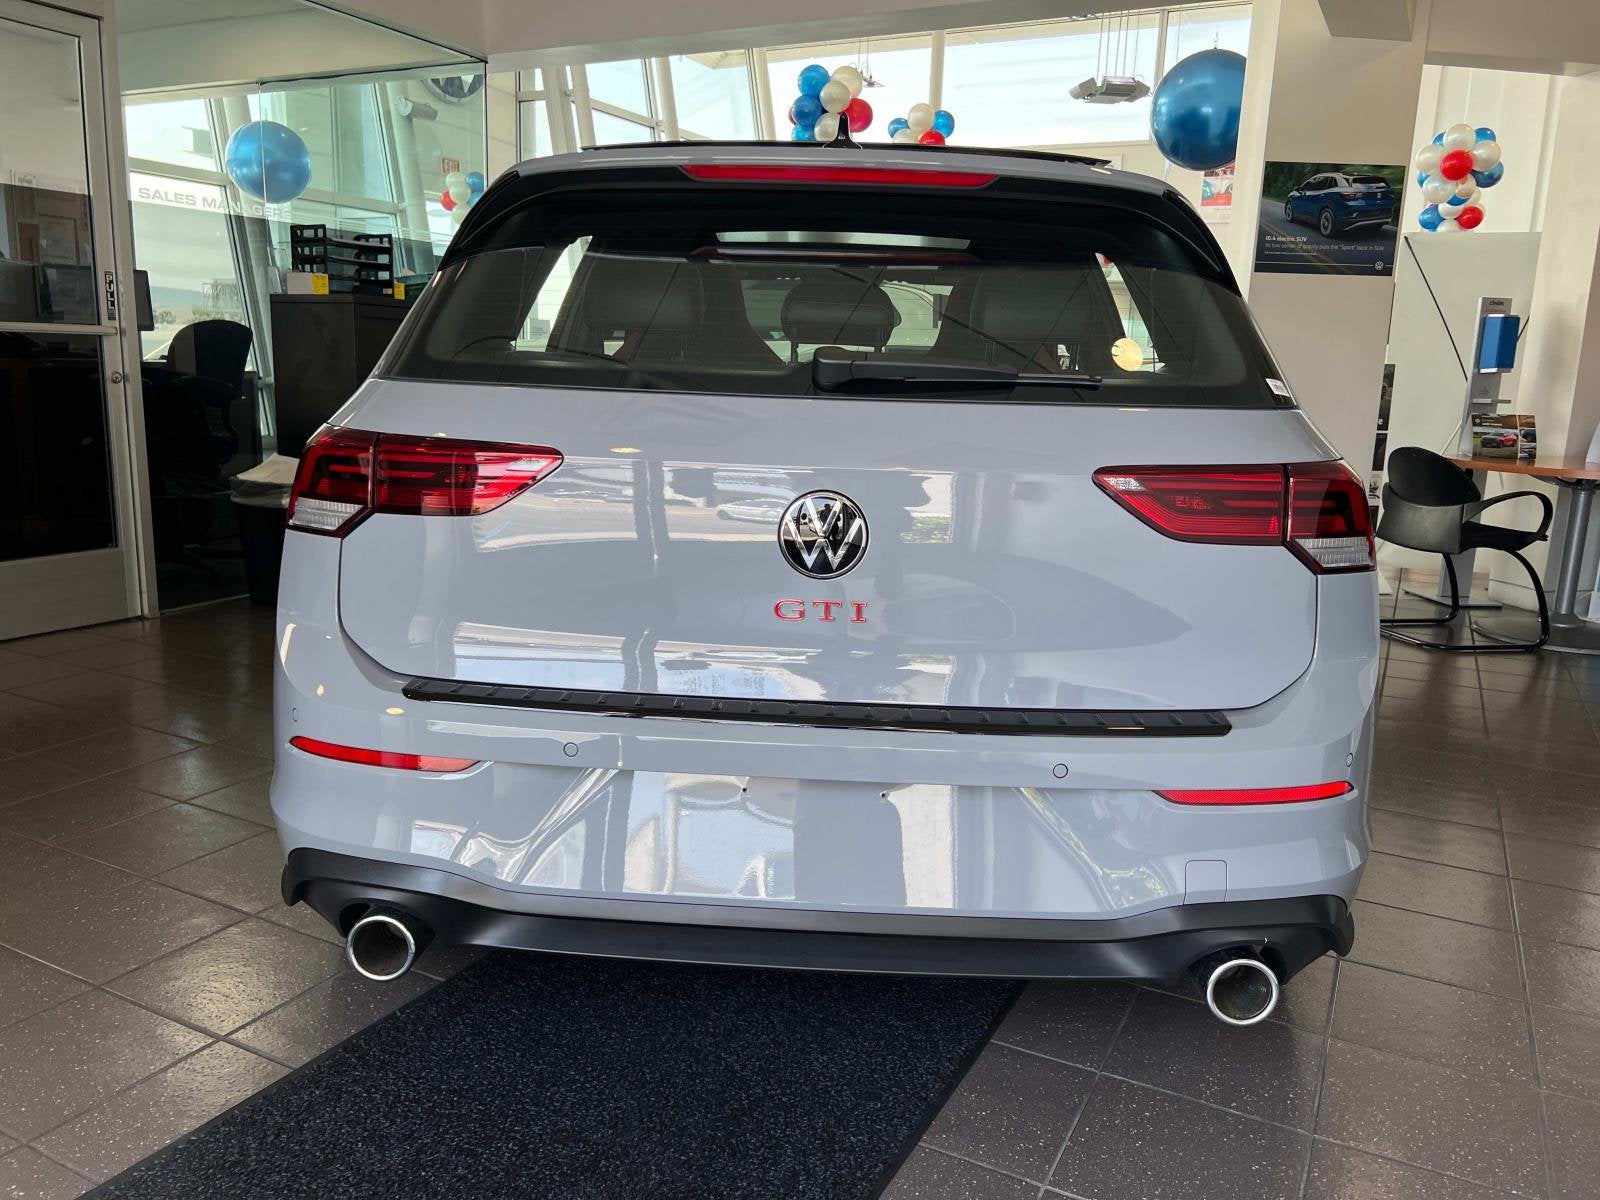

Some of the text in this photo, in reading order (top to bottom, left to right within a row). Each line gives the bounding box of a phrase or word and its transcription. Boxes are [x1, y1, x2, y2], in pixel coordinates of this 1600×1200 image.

[138, 187, 197, 206] SALES
[105, 274, 115, 310] PULL
[773, 599, 869, 623] GTI
